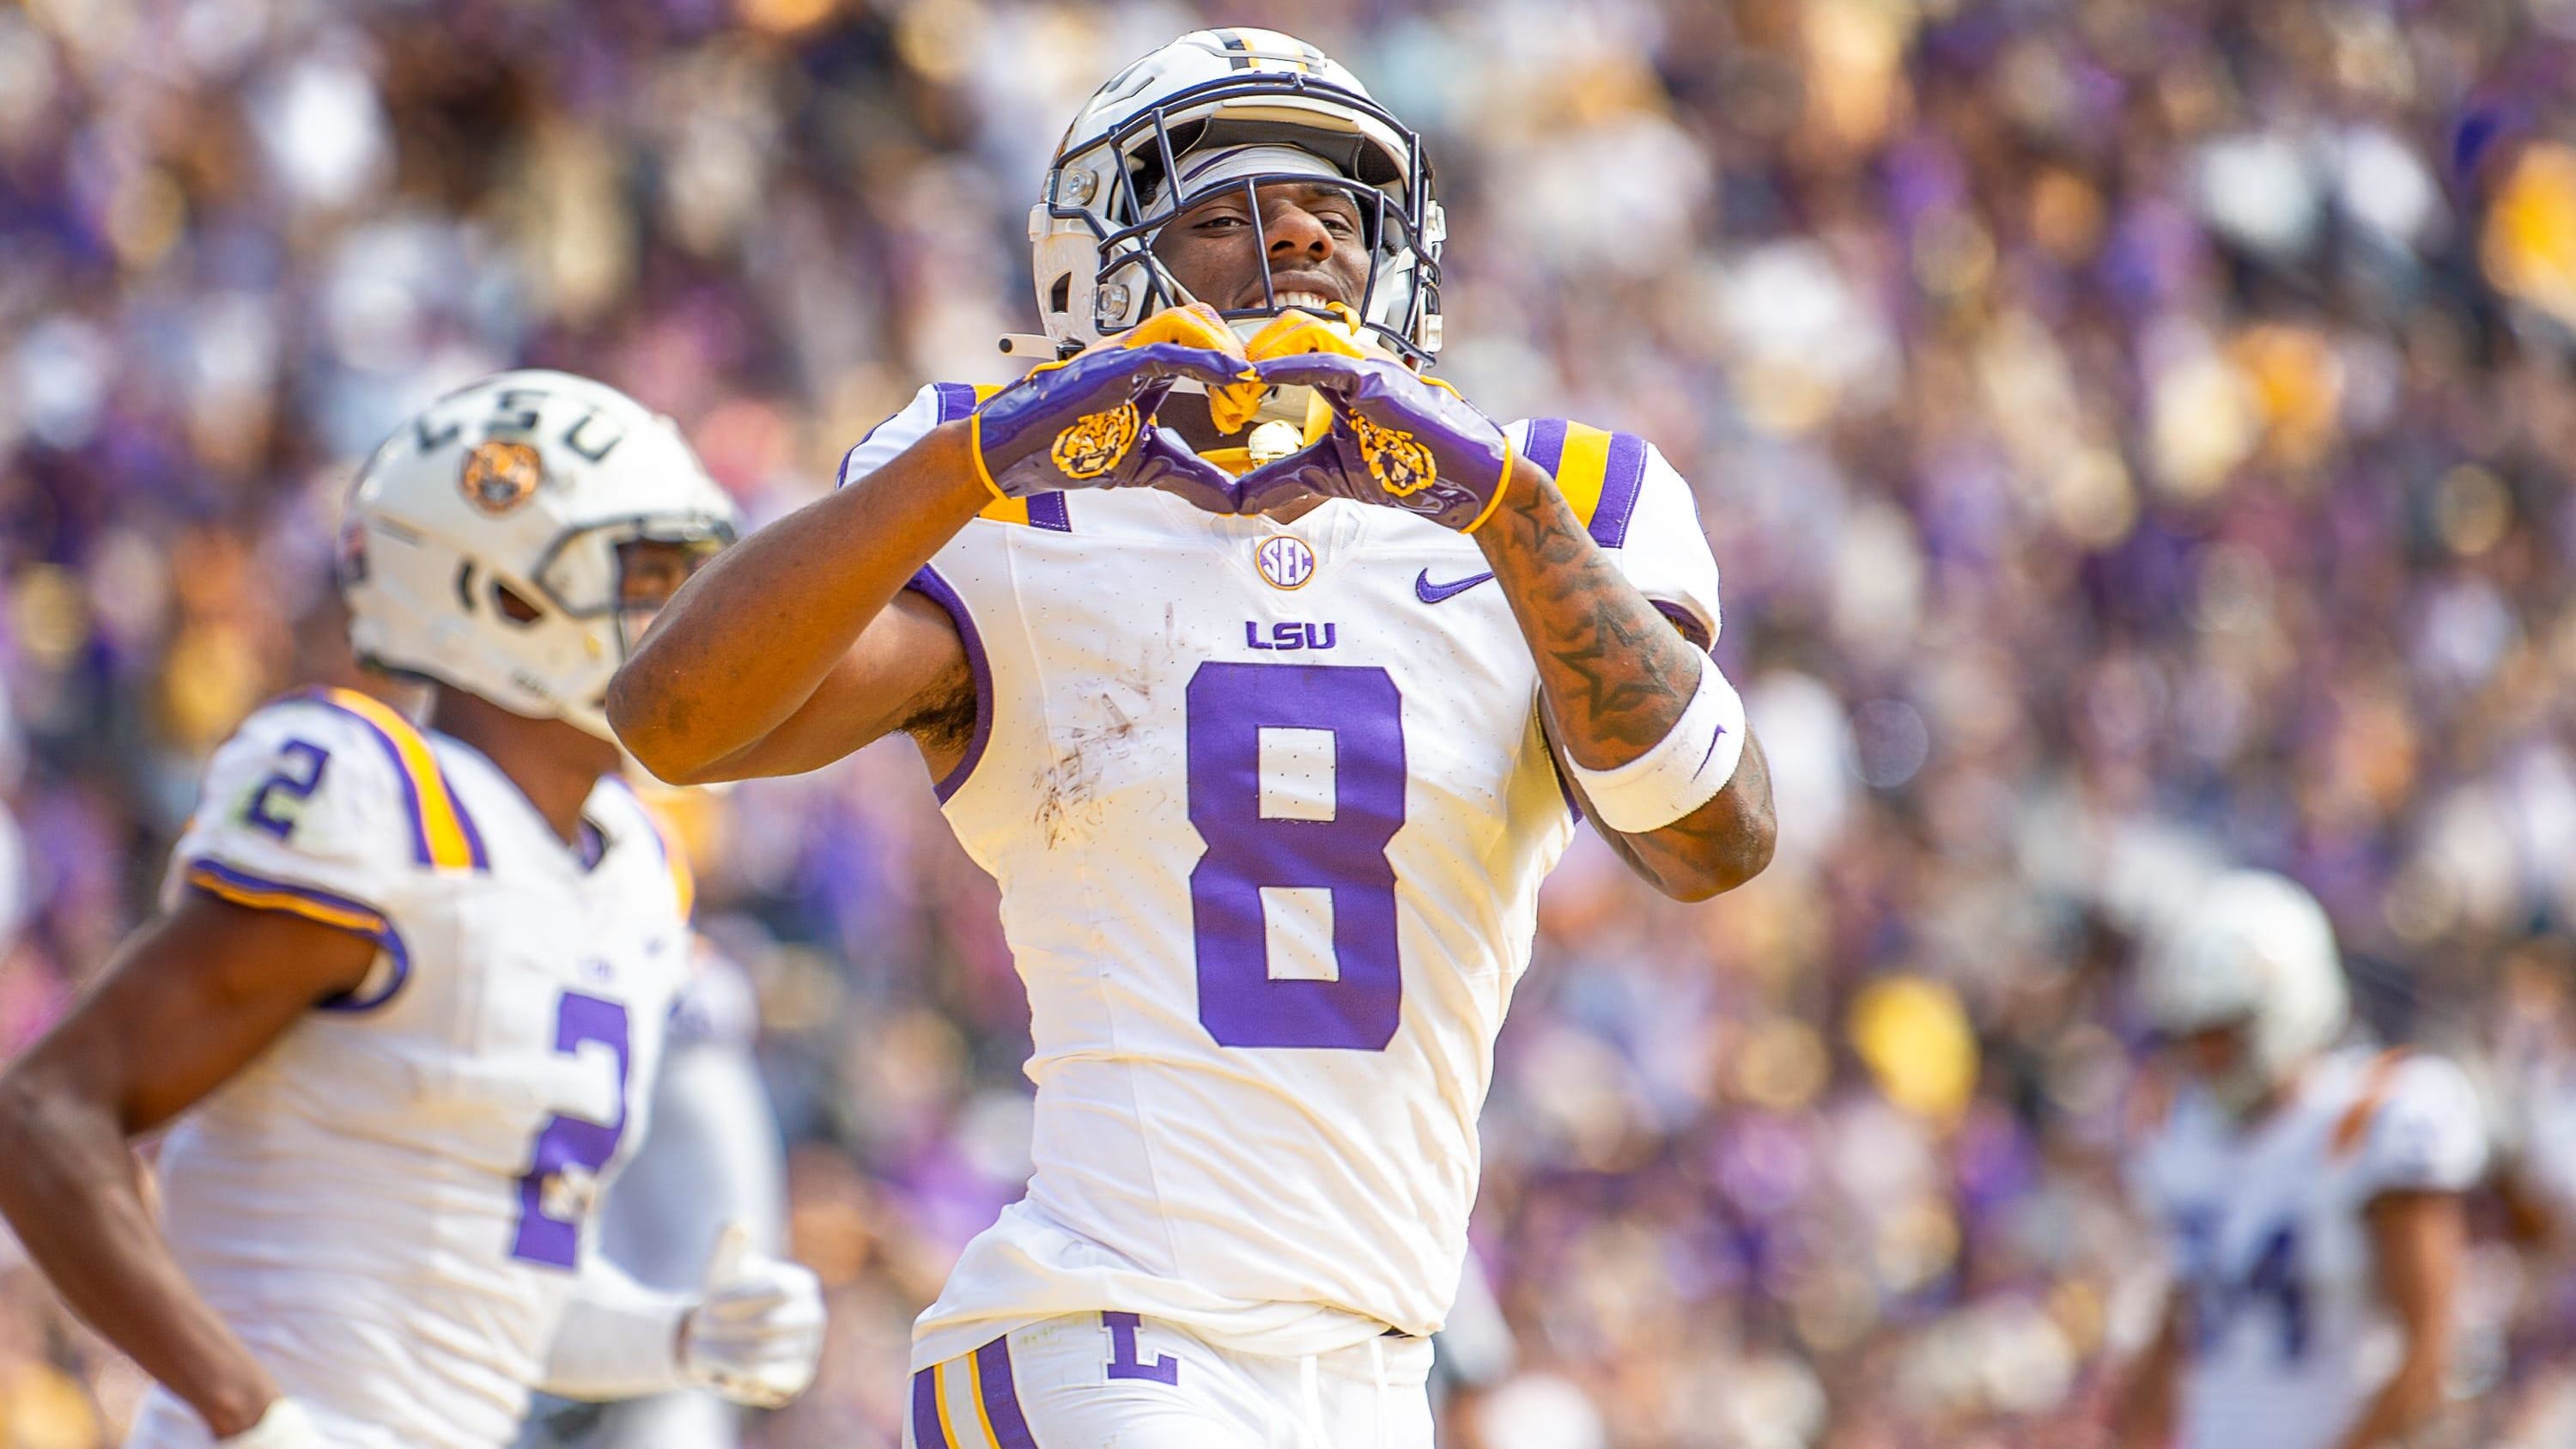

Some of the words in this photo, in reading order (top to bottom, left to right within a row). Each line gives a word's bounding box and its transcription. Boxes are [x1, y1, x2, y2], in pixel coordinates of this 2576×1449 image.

[416, 388, 623, 462] LSU
[1260, 538, 1314, 586] SEC
[1245, 620, 1336, 649] LSU
[244, 740, 329, 840] 2
[1186, 661, 1406, 1051] 8
[513, 991, 629, 1269] 2
[1101, 1310, 1178, 1386] L
